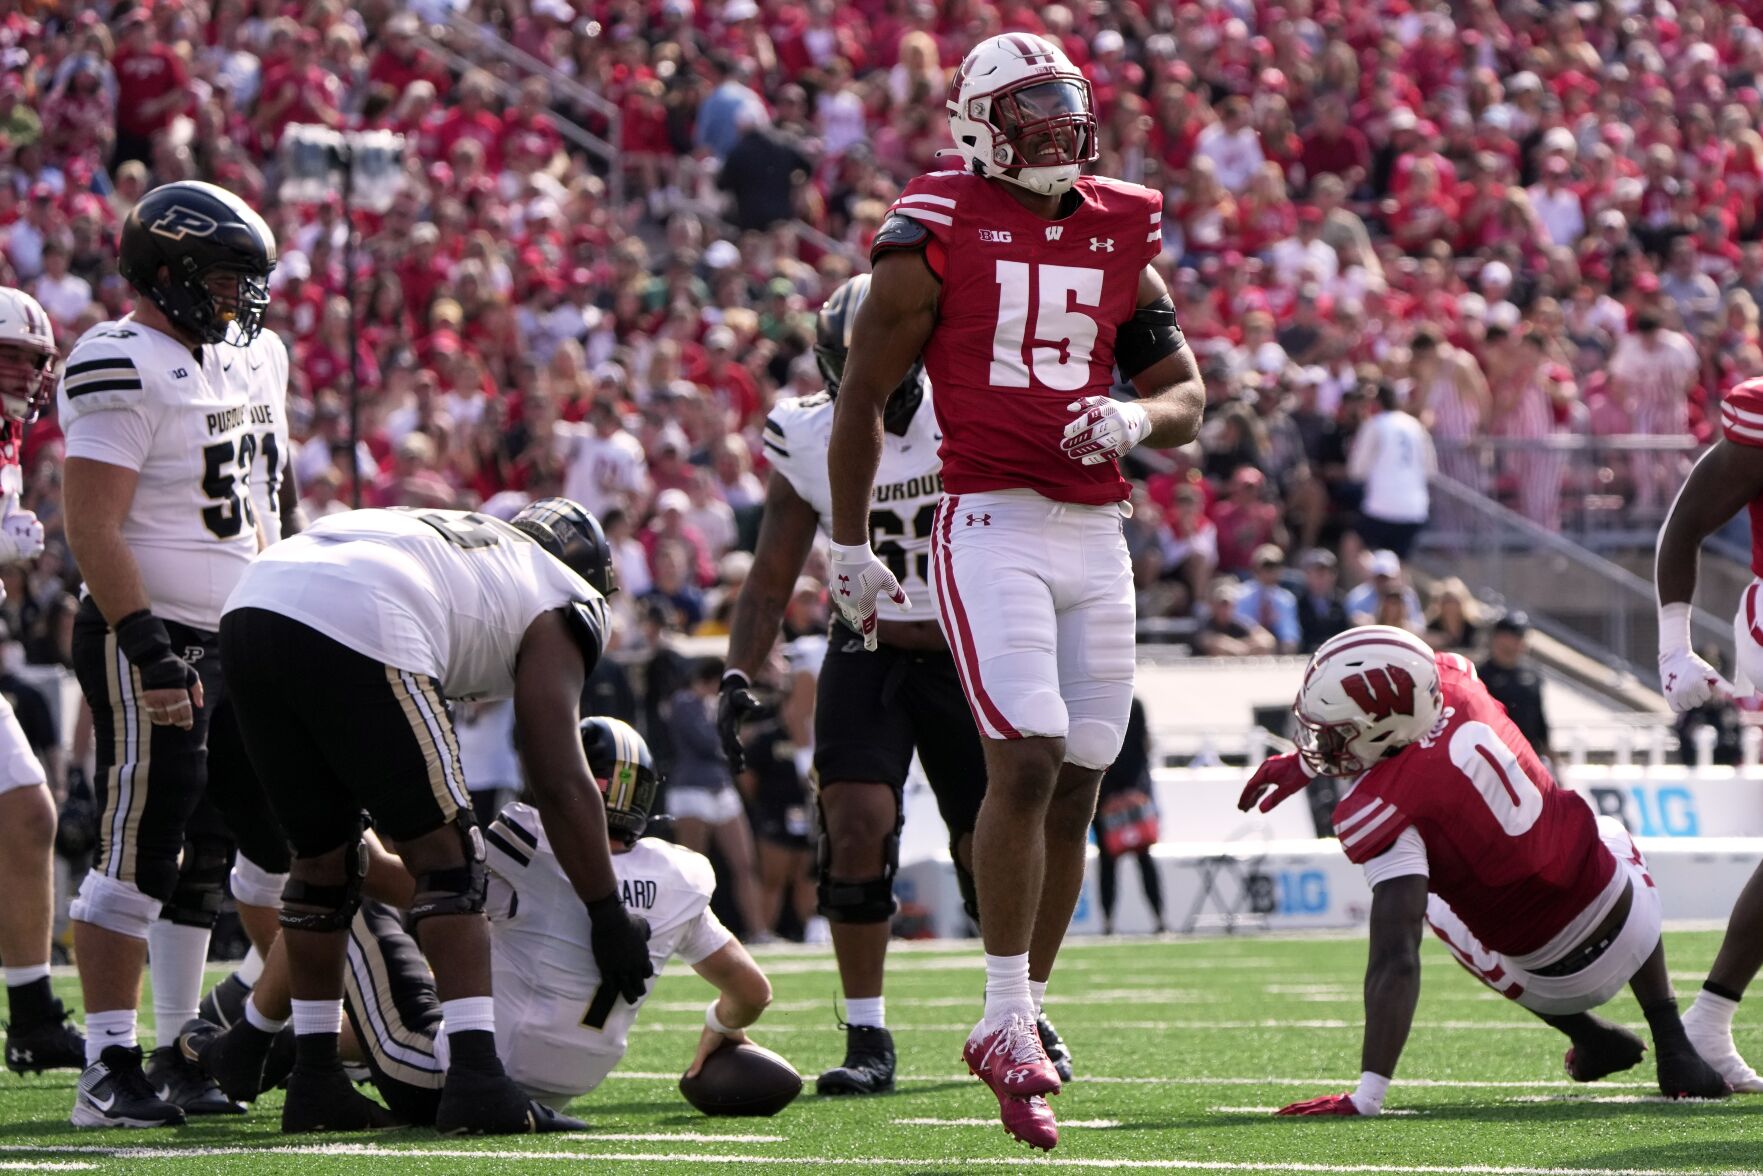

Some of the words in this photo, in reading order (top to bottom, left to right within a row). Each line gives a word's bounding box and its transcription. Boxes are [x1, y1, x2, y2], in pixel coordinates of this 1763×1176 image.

[150, 205, 218, 240] P
[1045, 226, 1064, 241] W
[989, 260, 1104, 391] 15
[1341, 663, 1417, 722] W
[1449, 720, 1543, 837] 0
